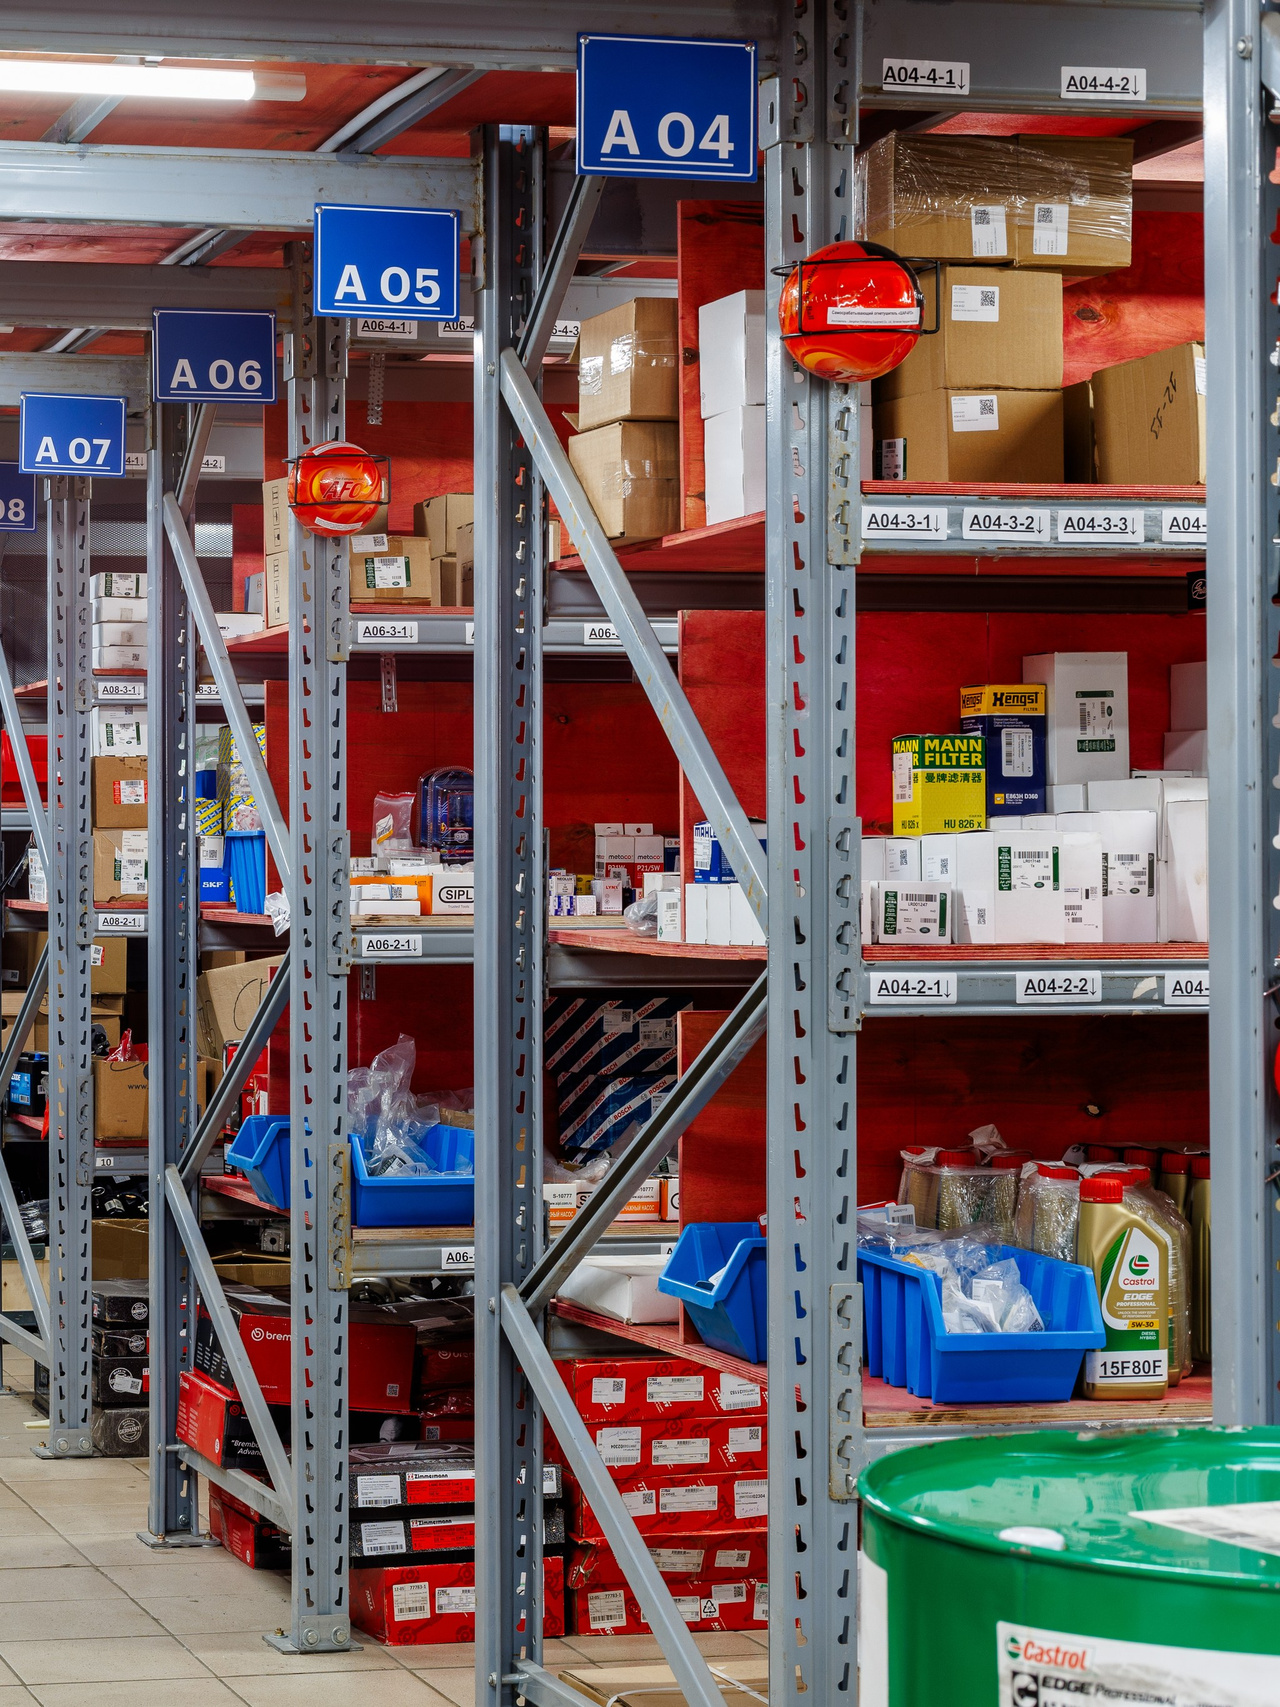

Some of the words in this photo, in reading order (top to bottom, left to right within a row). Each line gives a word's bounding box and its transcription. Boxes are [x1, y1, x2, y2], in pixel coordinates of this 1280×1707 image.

[883, 66, 956, 88] A04-4-1
[1066, 76, 1130, 93] A04-4-2
[601, 110, 640, 155] A
[658, 112, 735, 159] 04
[335, 265, 367, 301] A
[380, 267, 441, 304] 05
[361, 319, 407, 334] A06-4-1
[170, 359, 198, 389] A
[209, 360, 262, 390] 06
[35, 437, 59, 463] A
[69, 438, 111, 464] 07
[868, 514, 933, 531] A04-3-1
[969, 514, 1035, 532] A04-3-2
[1064, 516, 1129, 534] A04-3-3
[363, 626, 408, 636] A06-3-1
[102, 685, 136, 695] A08-3-1
[992, 691, 1040, 707] Hengst
[893, 740, 919, 753] MANN
[924, 739, 982, 752] MANN
[924, 753, 983, 766] FILTER
[901, 820, 907, 829] HU
[944, 819, 956, 829] HU
[958, 819, 975, 829] 826
[976, 821, 982, 829] x
[102, 916, 137, 927] A08-2-1
[367, 940, 412, 950] A06-2-1
[878, 979, 943, 995] A04-2-1
[1024, 976, 1090, 995] A04-2-2
[637, 1002, 656, 1018] BOSCH
[648, 1080, 667, 1096] BOSCH
[613, 1105, 633, 1121] BOSCH
[101, 1158, 111, 1167] 10
[446, 1252, 474, 1263] A06-
[1123, 1278, 1155, 1286] Castrol
[1100, 1360, 1162, 1376] 15F80F
[1023, 1640, 1087, 1671] Castrol
[1042, 1676, 1090, 1695] EDGE
